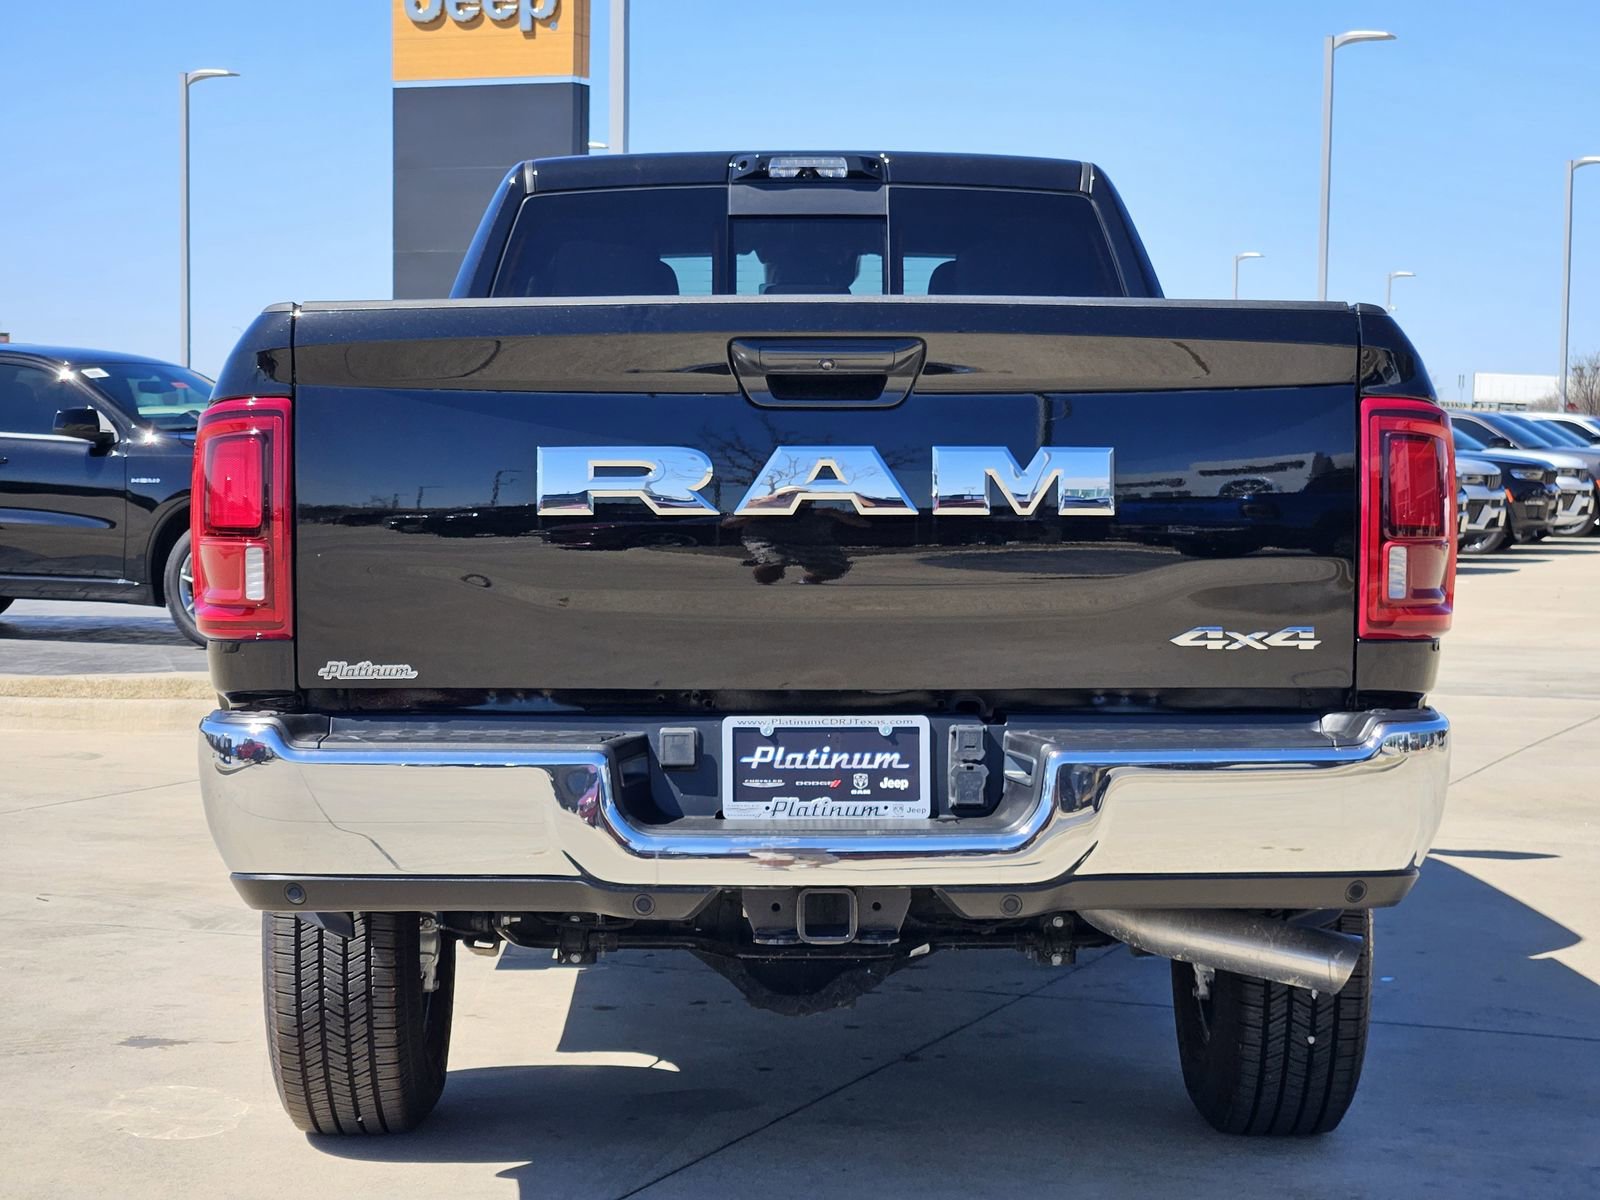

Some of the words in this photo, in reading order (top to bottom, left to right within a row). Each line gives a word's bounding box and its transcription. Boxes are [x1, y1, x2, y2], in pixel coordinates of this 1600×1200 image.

[537, 446, 1115, 515] RAM
[1169, 626, 1322, 650] 4x4
[318, 661, 418, 679] Platinum
[740, 746, 910, 769] Platinum
[880, 776, 909, 790] Jeep
[771, 801, 886, 817] Platinum
[906, 806, 927, 815] Jeep
